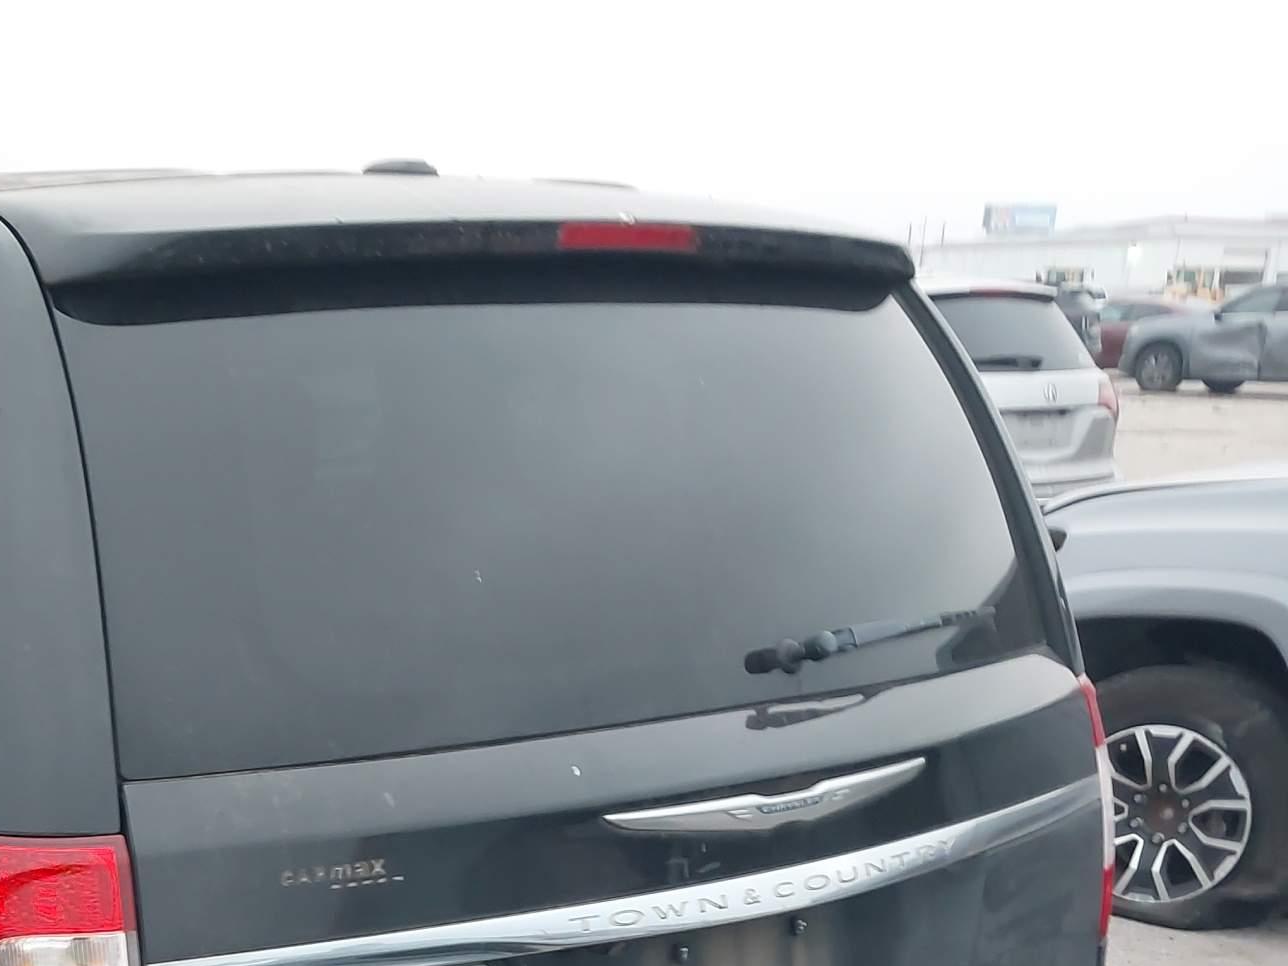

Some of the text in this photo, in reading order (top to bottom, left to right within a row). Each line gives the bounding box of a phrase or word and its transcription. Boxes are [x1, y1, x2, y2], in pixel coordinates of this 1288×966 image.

[568, 836, 958, 932] TOWN & COUNTRY
